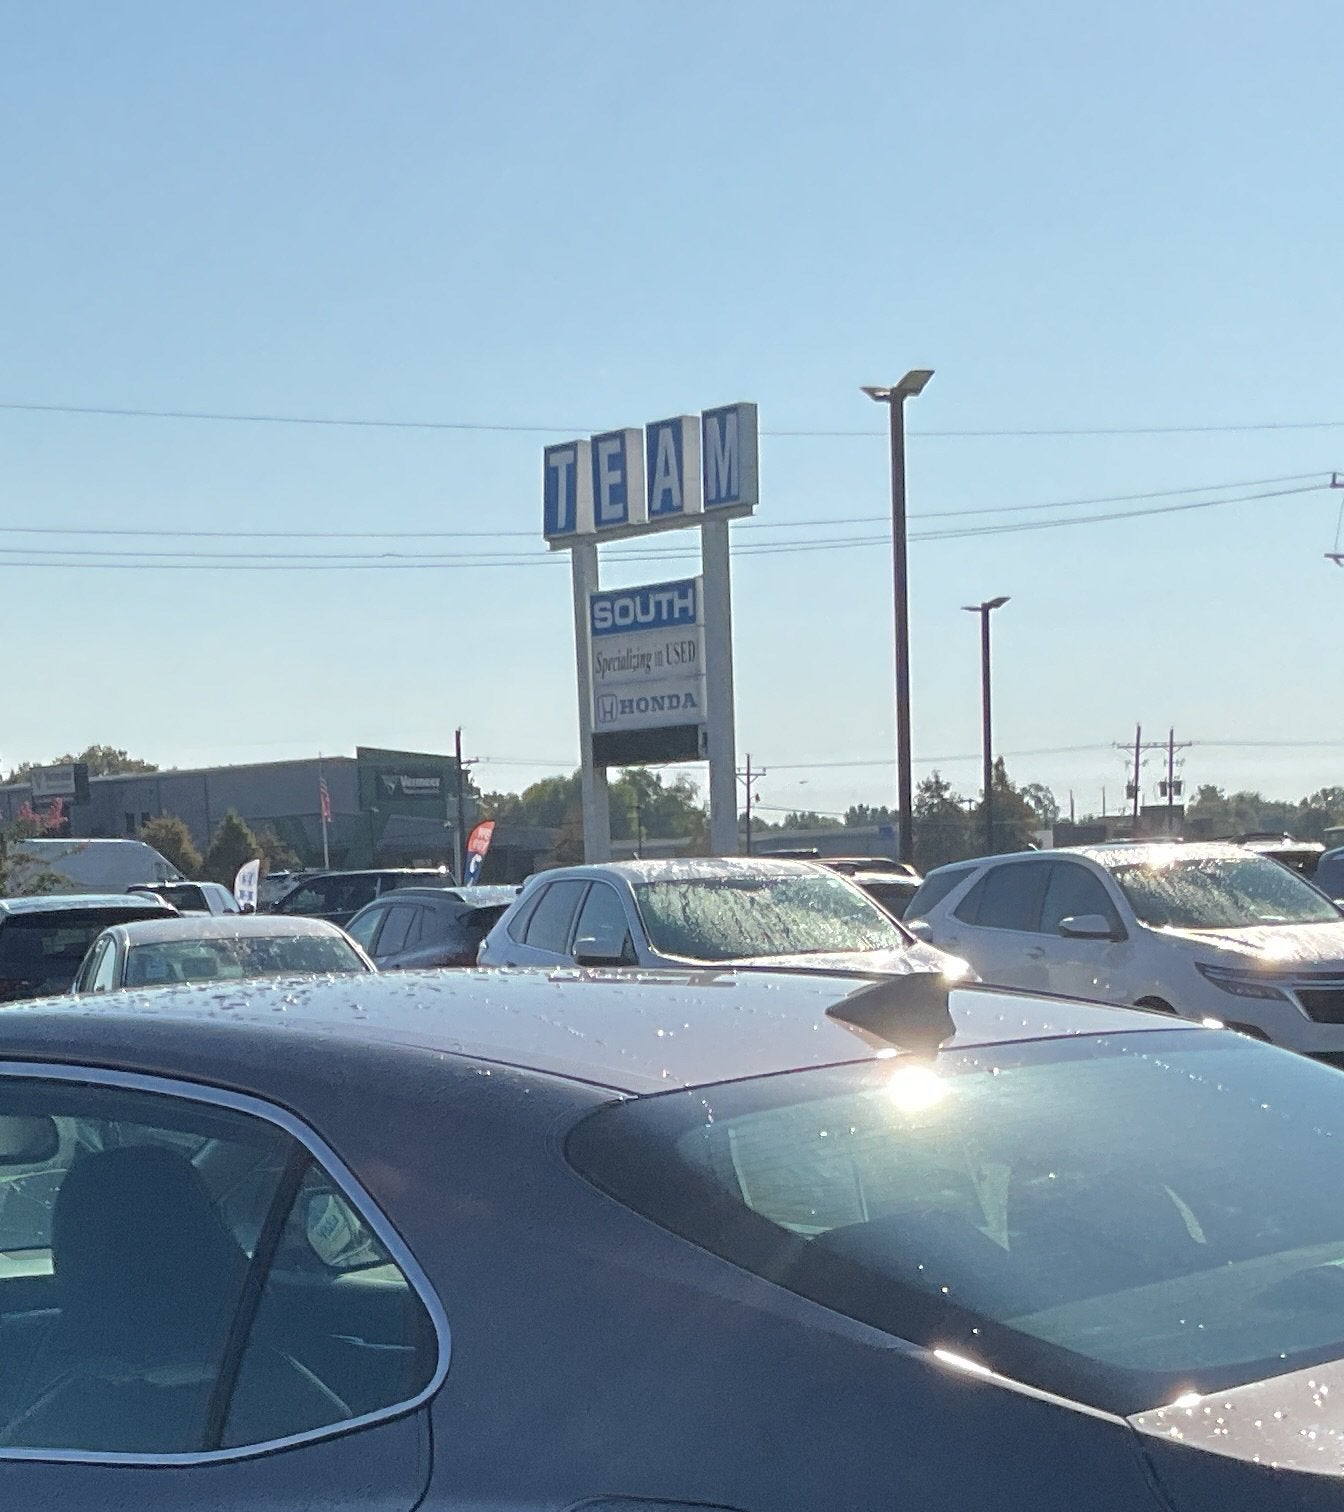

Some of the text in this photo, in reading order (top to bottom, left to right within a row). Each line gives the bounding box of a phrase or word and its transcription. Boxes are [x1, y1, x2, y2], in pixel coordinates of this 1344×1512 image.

[548, 412, 739, 529] TEAM
[592, 588, 694, 630] SOUTH
[595, 647, 653, 680] Specializing
[665, 639, 696, 666] USED
[619, 692, 698, 716] HONDA
